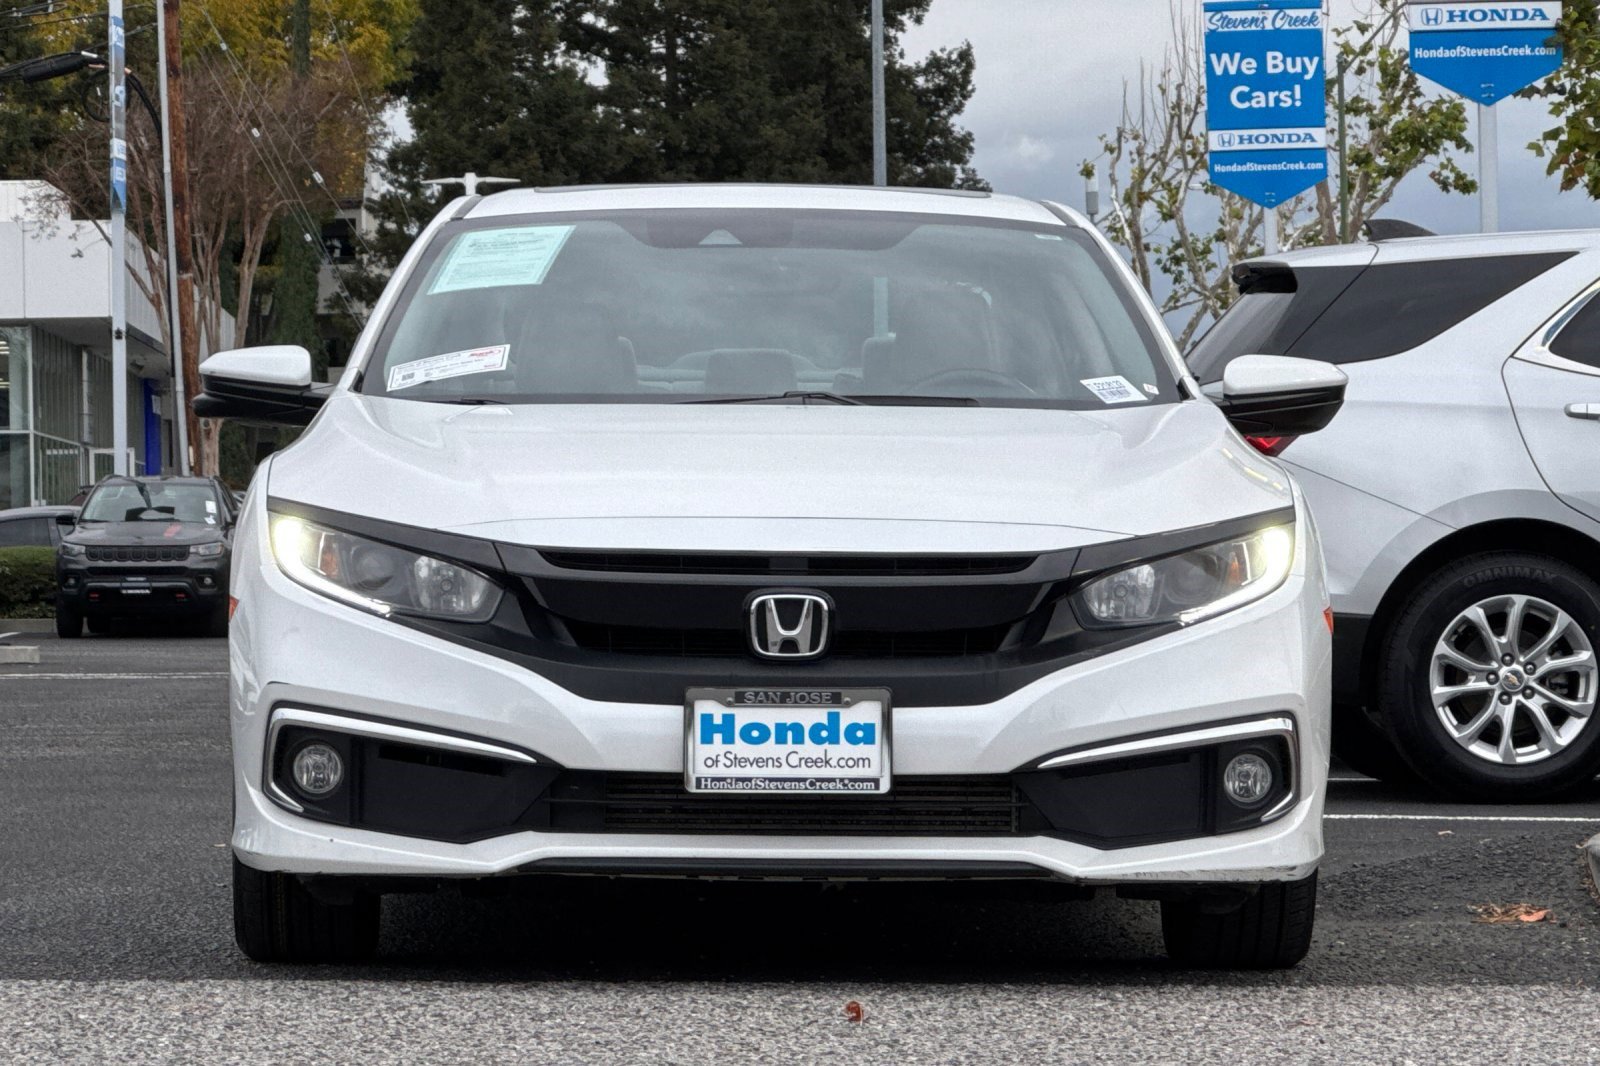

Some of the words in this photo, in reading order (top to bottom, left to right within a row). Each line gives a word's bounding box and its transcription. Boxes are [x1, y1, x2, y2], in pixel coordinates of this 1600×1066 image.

[1207, 10, 1268, 32] Stevens
[1271, 9, 1320, 30] Creek
[1446, 8, 1549, 23] HONDA
[1414, 45, 1557, 59] HondaofStevensCreek.com
[1209, 52, 1258, 76] We
[1266, 51, 1319, 80] Buy
[1230, 84, 1302, 109] Cars!
[1237, 132, 1317, 145] HONDA
[1214, 161, 1324, 173] HondaofStevensCreek.com
[744, 691, 780, 704] SAN
[786, 692, 832, 704] JOSE
[700, 711, 876, 746] Honda
[703, 753, 721, 768] of
[723, 750, 783, 769] Stevens
[785, 749, 871, 769] Creek.com
